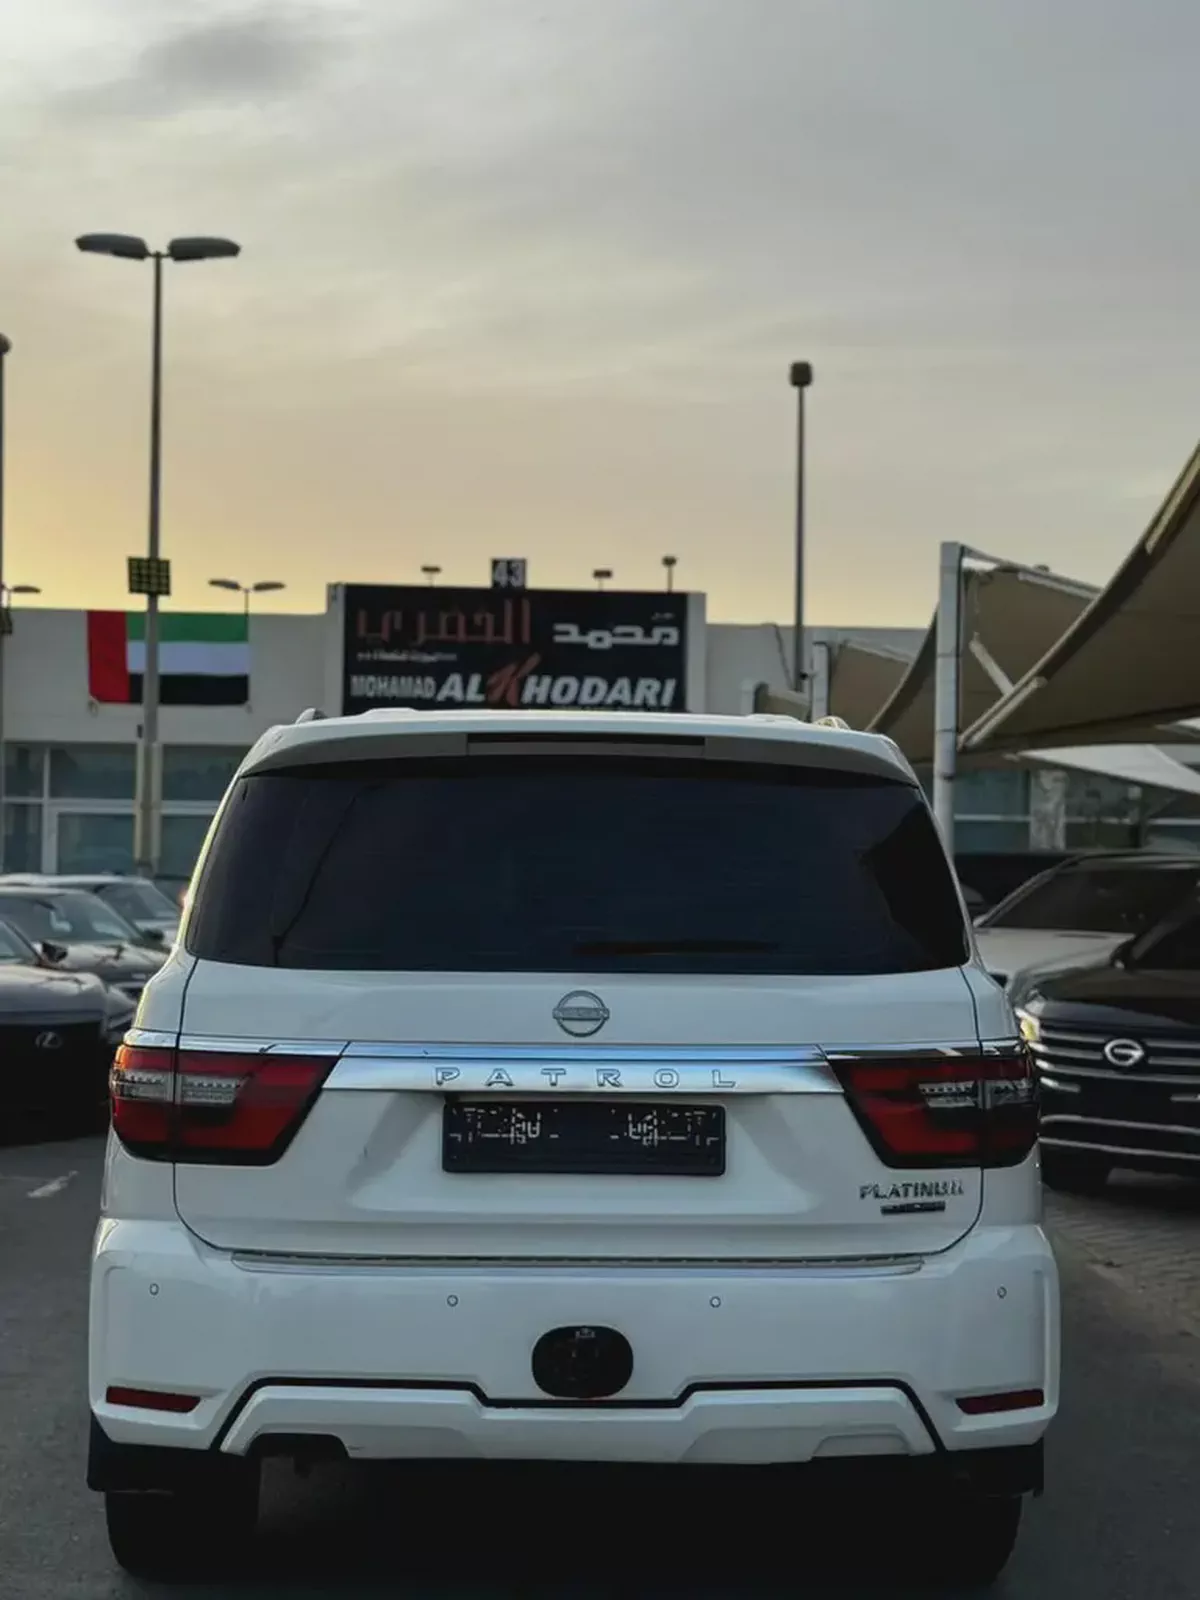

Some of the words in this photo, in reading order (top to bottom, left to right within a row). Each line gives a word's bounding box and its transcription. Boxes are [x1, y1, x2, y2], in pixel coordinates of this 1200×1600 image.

[494, 562, 524, 588] 43
[552, 622, 681, 650] محمد
[436, 671, 485, 702] AL
[434, 1067, 737, 1089] PATROL
